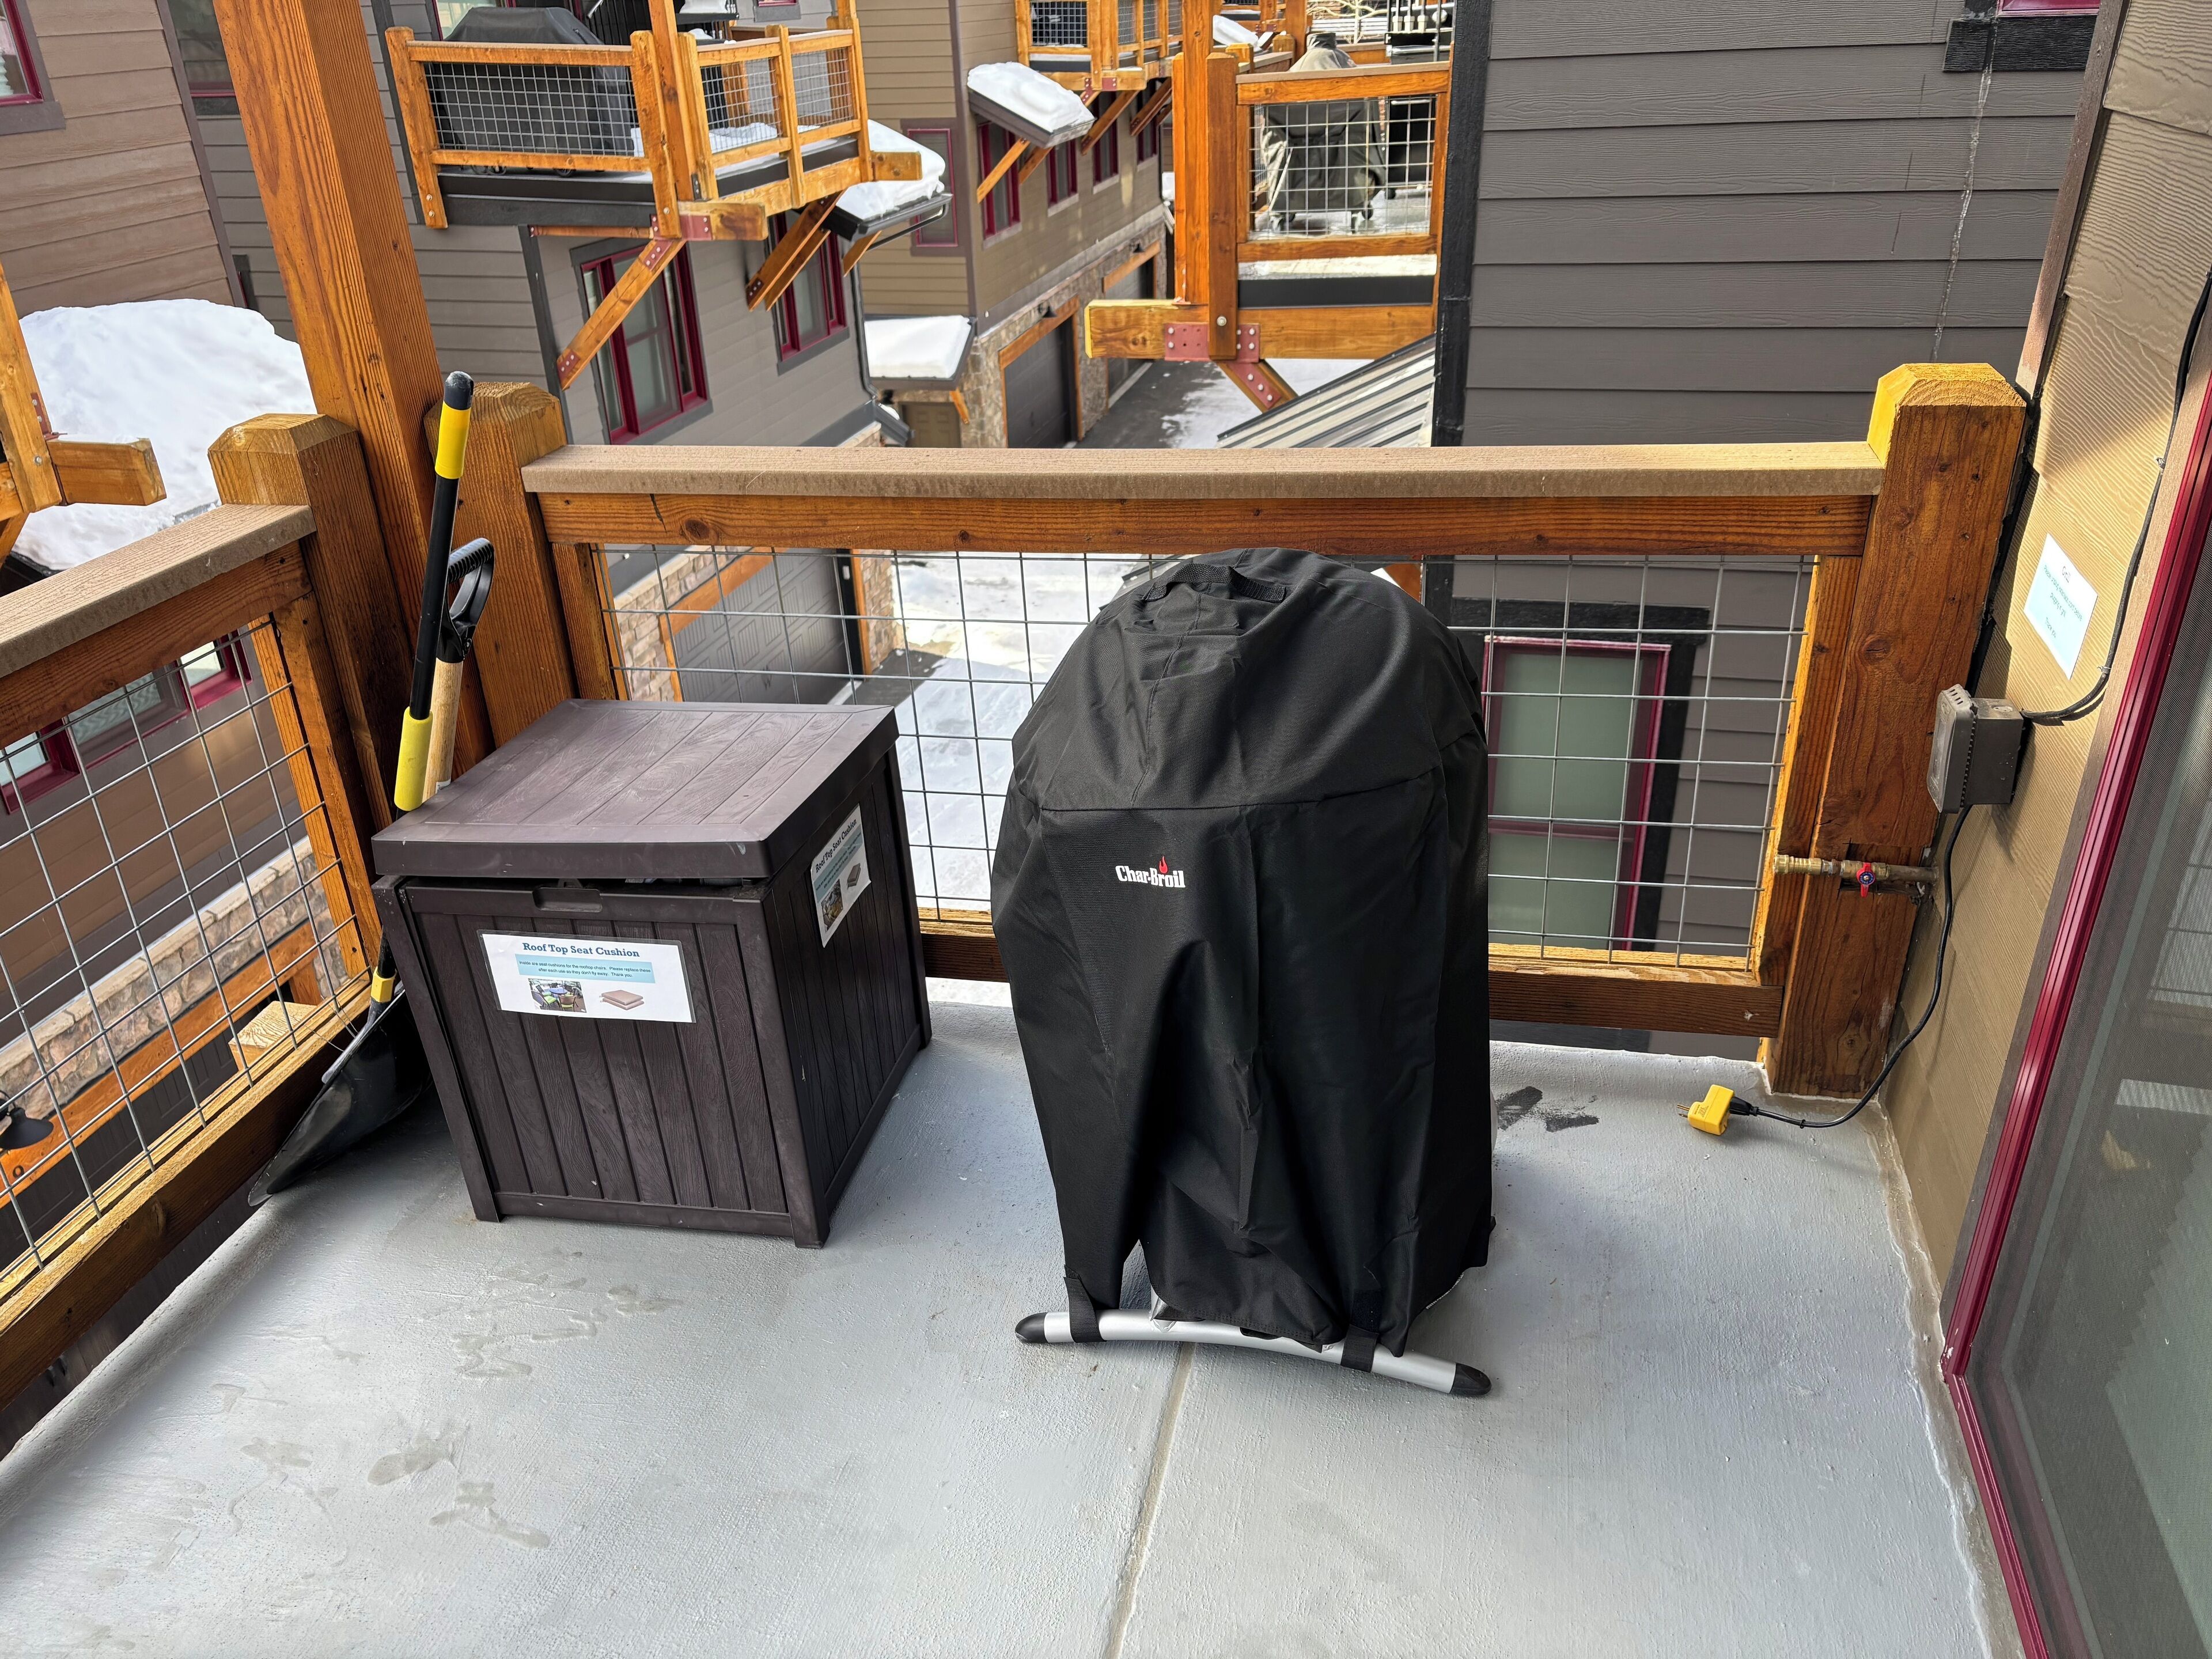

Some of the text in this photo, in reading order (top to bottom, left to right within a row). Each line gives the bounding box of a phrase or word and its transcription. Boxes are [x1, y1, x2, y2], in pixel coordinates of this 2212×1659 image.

[816, 819, 857, 873] Roof Top Seat Cushion
[1115, 865, 1186, 888] Char-Broil
[522, 942, 640, 957] Roof Top Seat Cushion
